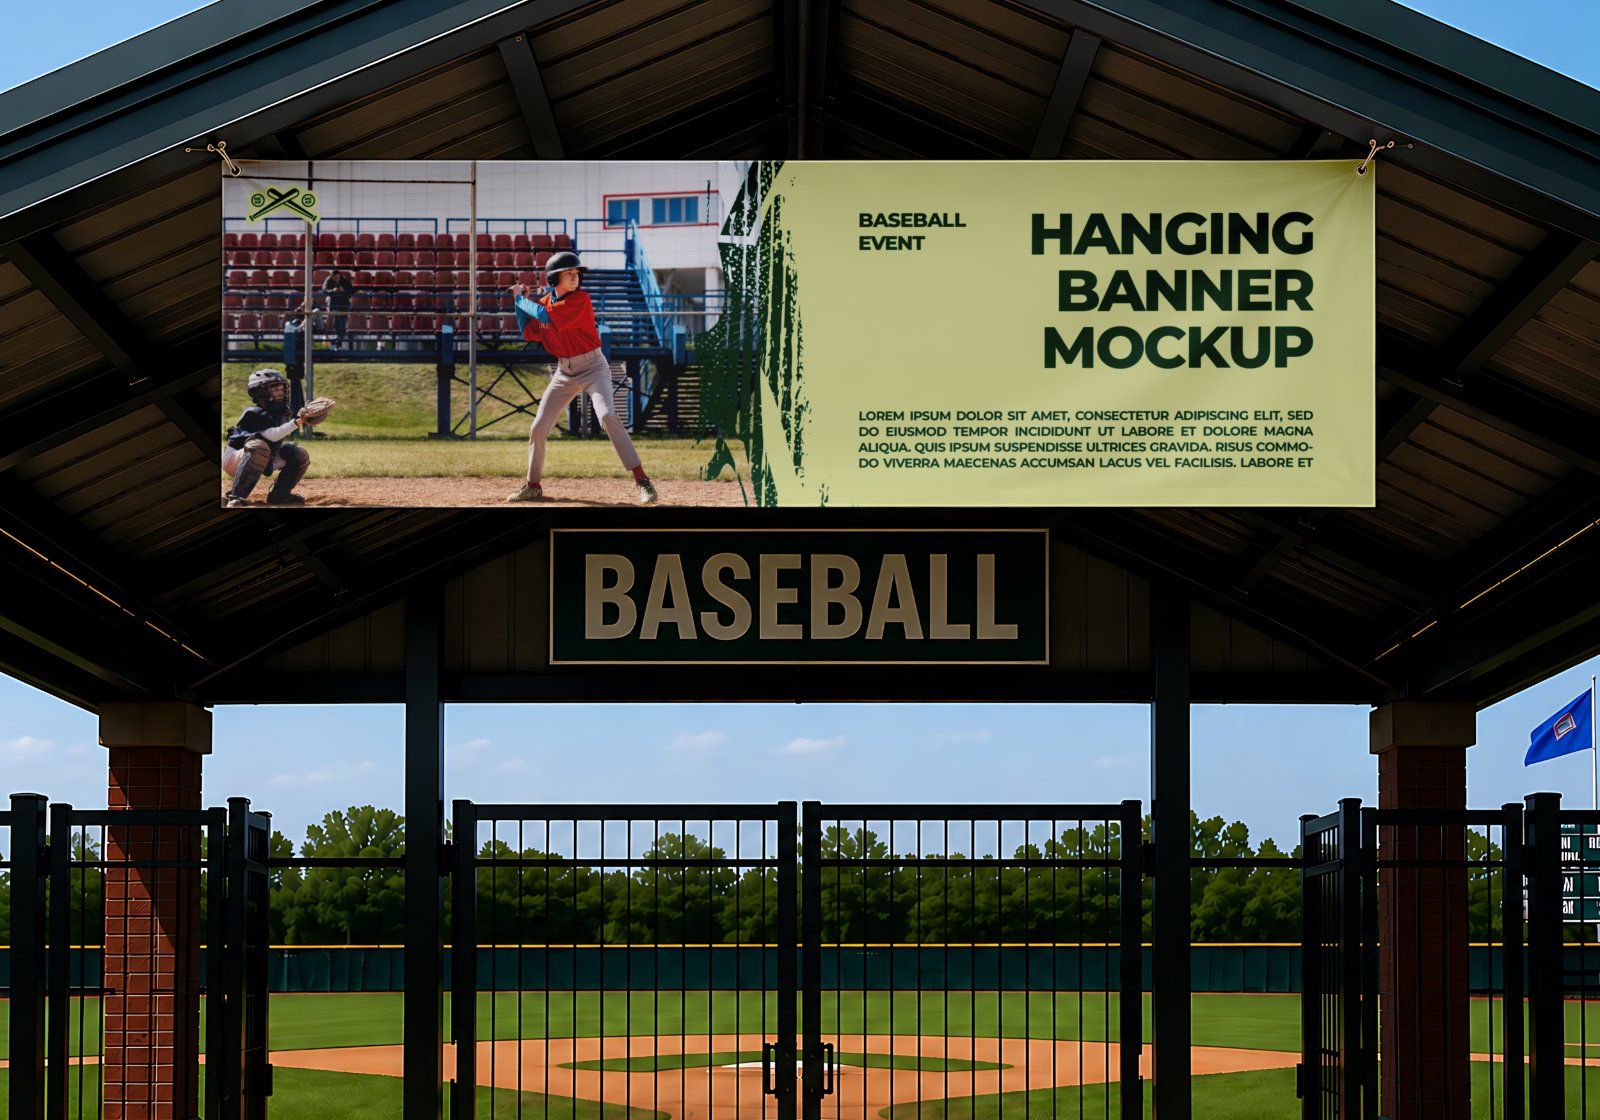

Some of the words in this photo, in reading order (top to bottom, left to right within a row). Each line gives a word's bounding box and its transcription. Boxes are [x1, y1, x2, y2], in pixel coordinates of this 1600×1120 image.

[859, 213, 966, 227] BASEBALL
[1032, 212, 1314, 255] HANGING
[859, 236, 925, 250] EVENT
[1059, 269, 1313, 311] BANNER
[1044, 326, 1313, 369] MOCKUP
[859, 411, 904, 421] LOREM
[911, 411, 951, 420] IPSUM
[957, 411, 1002, 421] DOLOR
[1008, 411, 1026, 420] SIT
[1031, 411, 1070, 422] AMET,
[1076, 411, 1169, 420] CONSECTETUR
[1174, 411, 1248, 420] ADIPISCING
[1254, 411, 1282, 422] ELIT,
[1288, 411, 1313, 420] SED
[859, 427, 879, 436] DO
[886, 427, 946, 436] EIUSMOD
[953, 427, 1008, 436] TEMPOR
[1016, 427, 1091, 436] INCIDIDUNT
[1098, 427, 1115, 436] UT
[1122, 427, 1174, 436] LABORE
[1181, 427, 1196, 436] ET
[1204, 426, 1257, 436] DOLORE
[1265, 426, 1313, 436] MAGNA
[859, 443, 911, 454] ALIQUA.
[915, 443, 946, 454] QUIS
[950, 443, 990, 452] IPSUM
[994, 442, 1082, 452] SUSPENDISSE
[1087, 442, 1146, 452] ULTRICES
[1150, 442, 1212, 452] GRAVIDA.
[1216, 442, 1253, 452] RISUS
[1256, 442, 1313, 452] COMMO-
[859, 459, 879, 468] DO
[883, 458, 939, 468] VIVERRA
[944, 458, 1016, 468] MAECENAS
[1021, 458, 1094, 467] ACCUMSAN
[1100, 458, 1142, 467] LACUS
[1146, 458, 1170, 467] VEL
[1175, 458, 1236, 467] FACILISIS.
[1241, 458, 1293, 467] LABORE
[1298, 458, 1313, 467] ET
[585, 553, 1017, 640] BASEBALL
